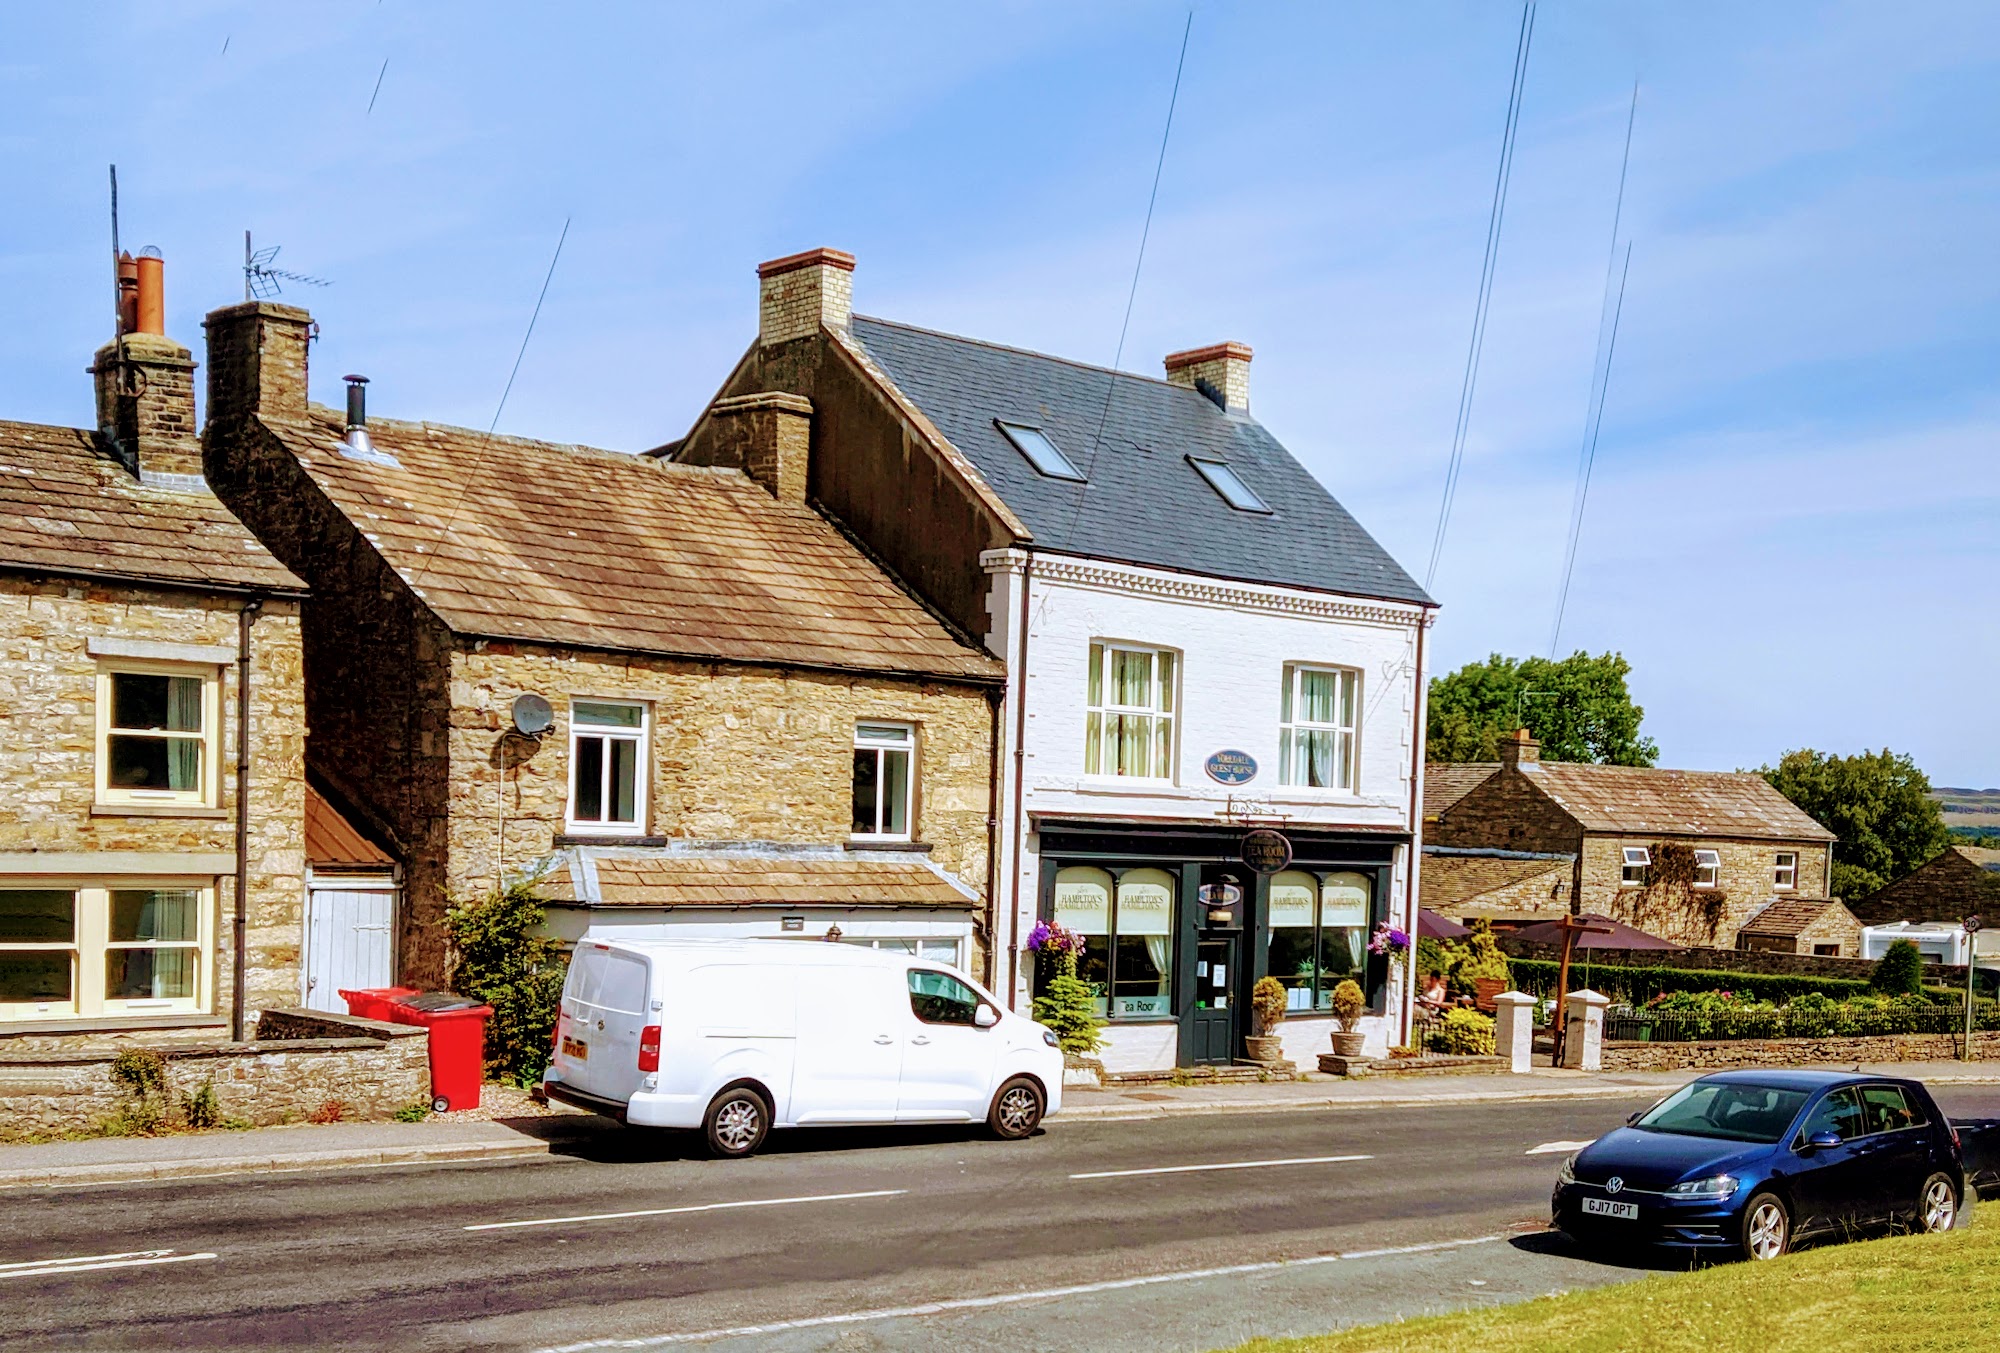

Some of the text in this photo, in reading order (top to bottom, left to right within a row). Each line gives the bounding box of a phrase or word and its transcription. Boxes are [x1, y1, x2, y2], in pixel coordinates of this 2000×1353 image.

[1246, 845, 1285, 857] TEA ROOM
[1061, 894, 1103, 904] HAMILTON'S
[1124, 895, 1164, 904] HAMILTON'S
[1965, 920, 1976, 928] 30
[1588, 1200, 1633, 1217] GJ17 OPT
